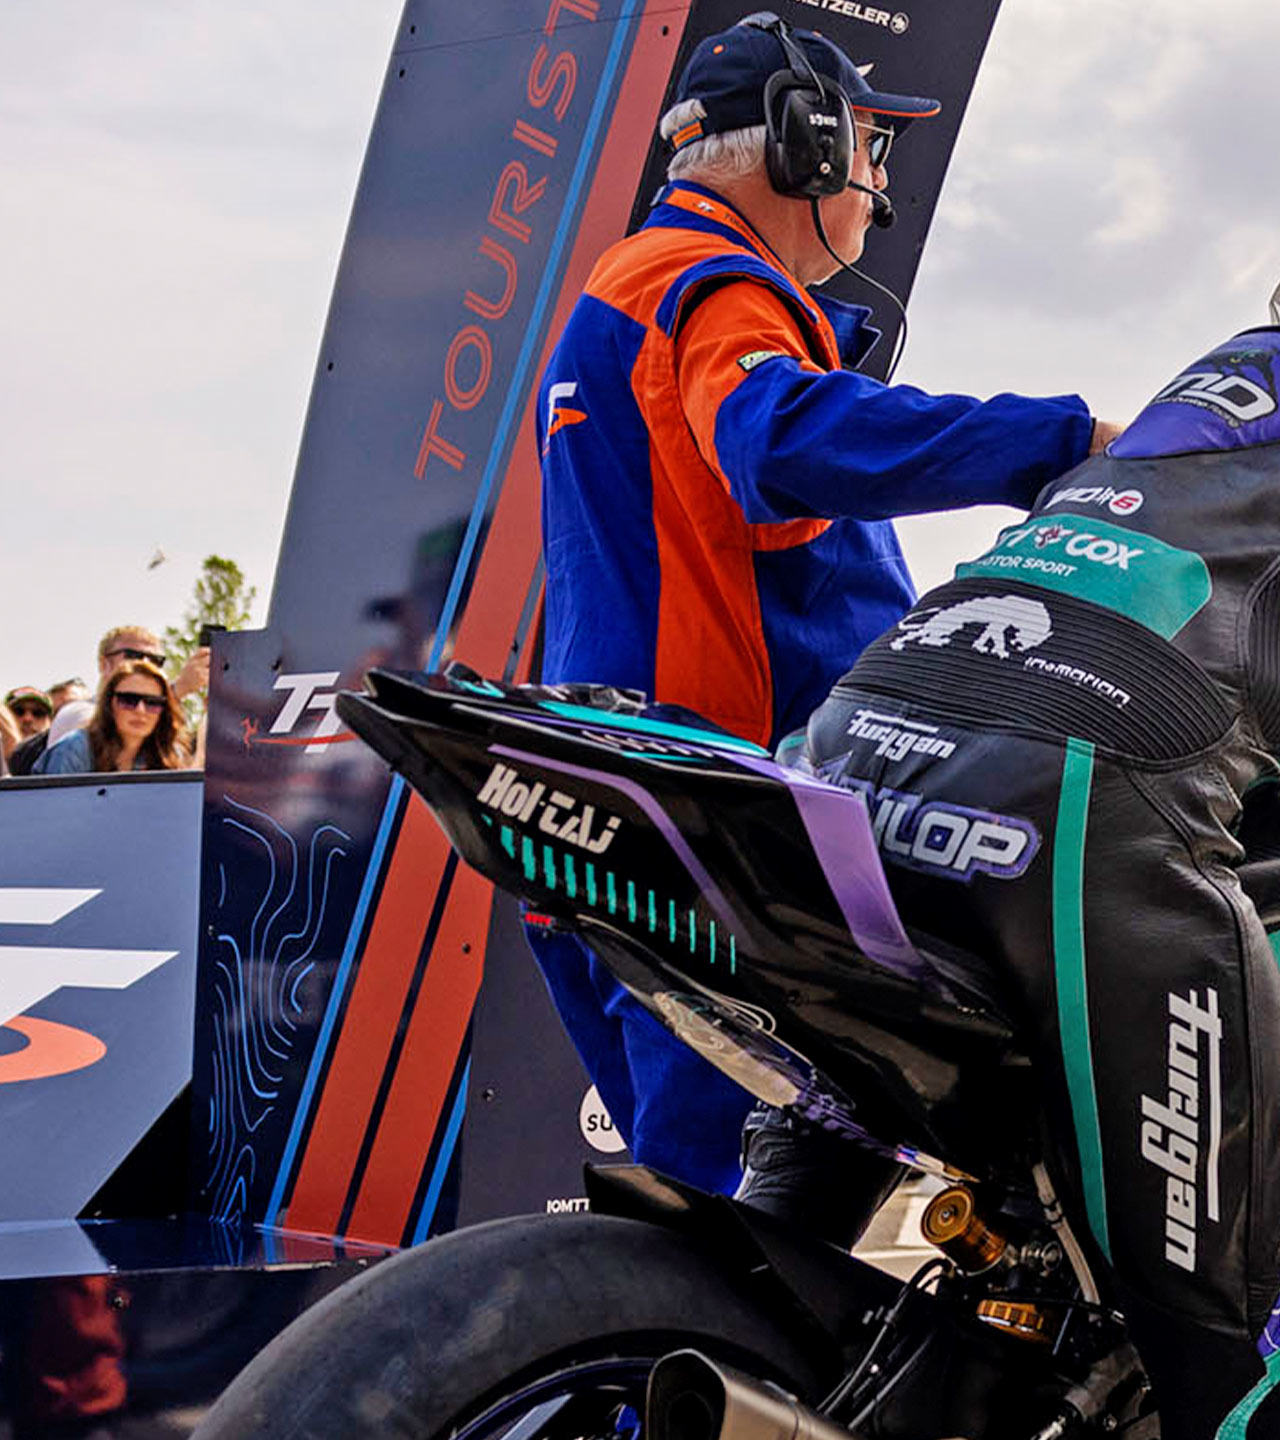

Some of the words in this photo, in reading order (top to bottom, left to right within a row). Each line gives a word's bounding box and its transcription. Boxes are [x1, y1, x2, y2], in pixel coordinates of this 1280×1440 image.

[796, 0, 891, 26] ETZELER
[414, 0, 600, 480] TOURIST
[587, 1114, 613, 1132] SU
